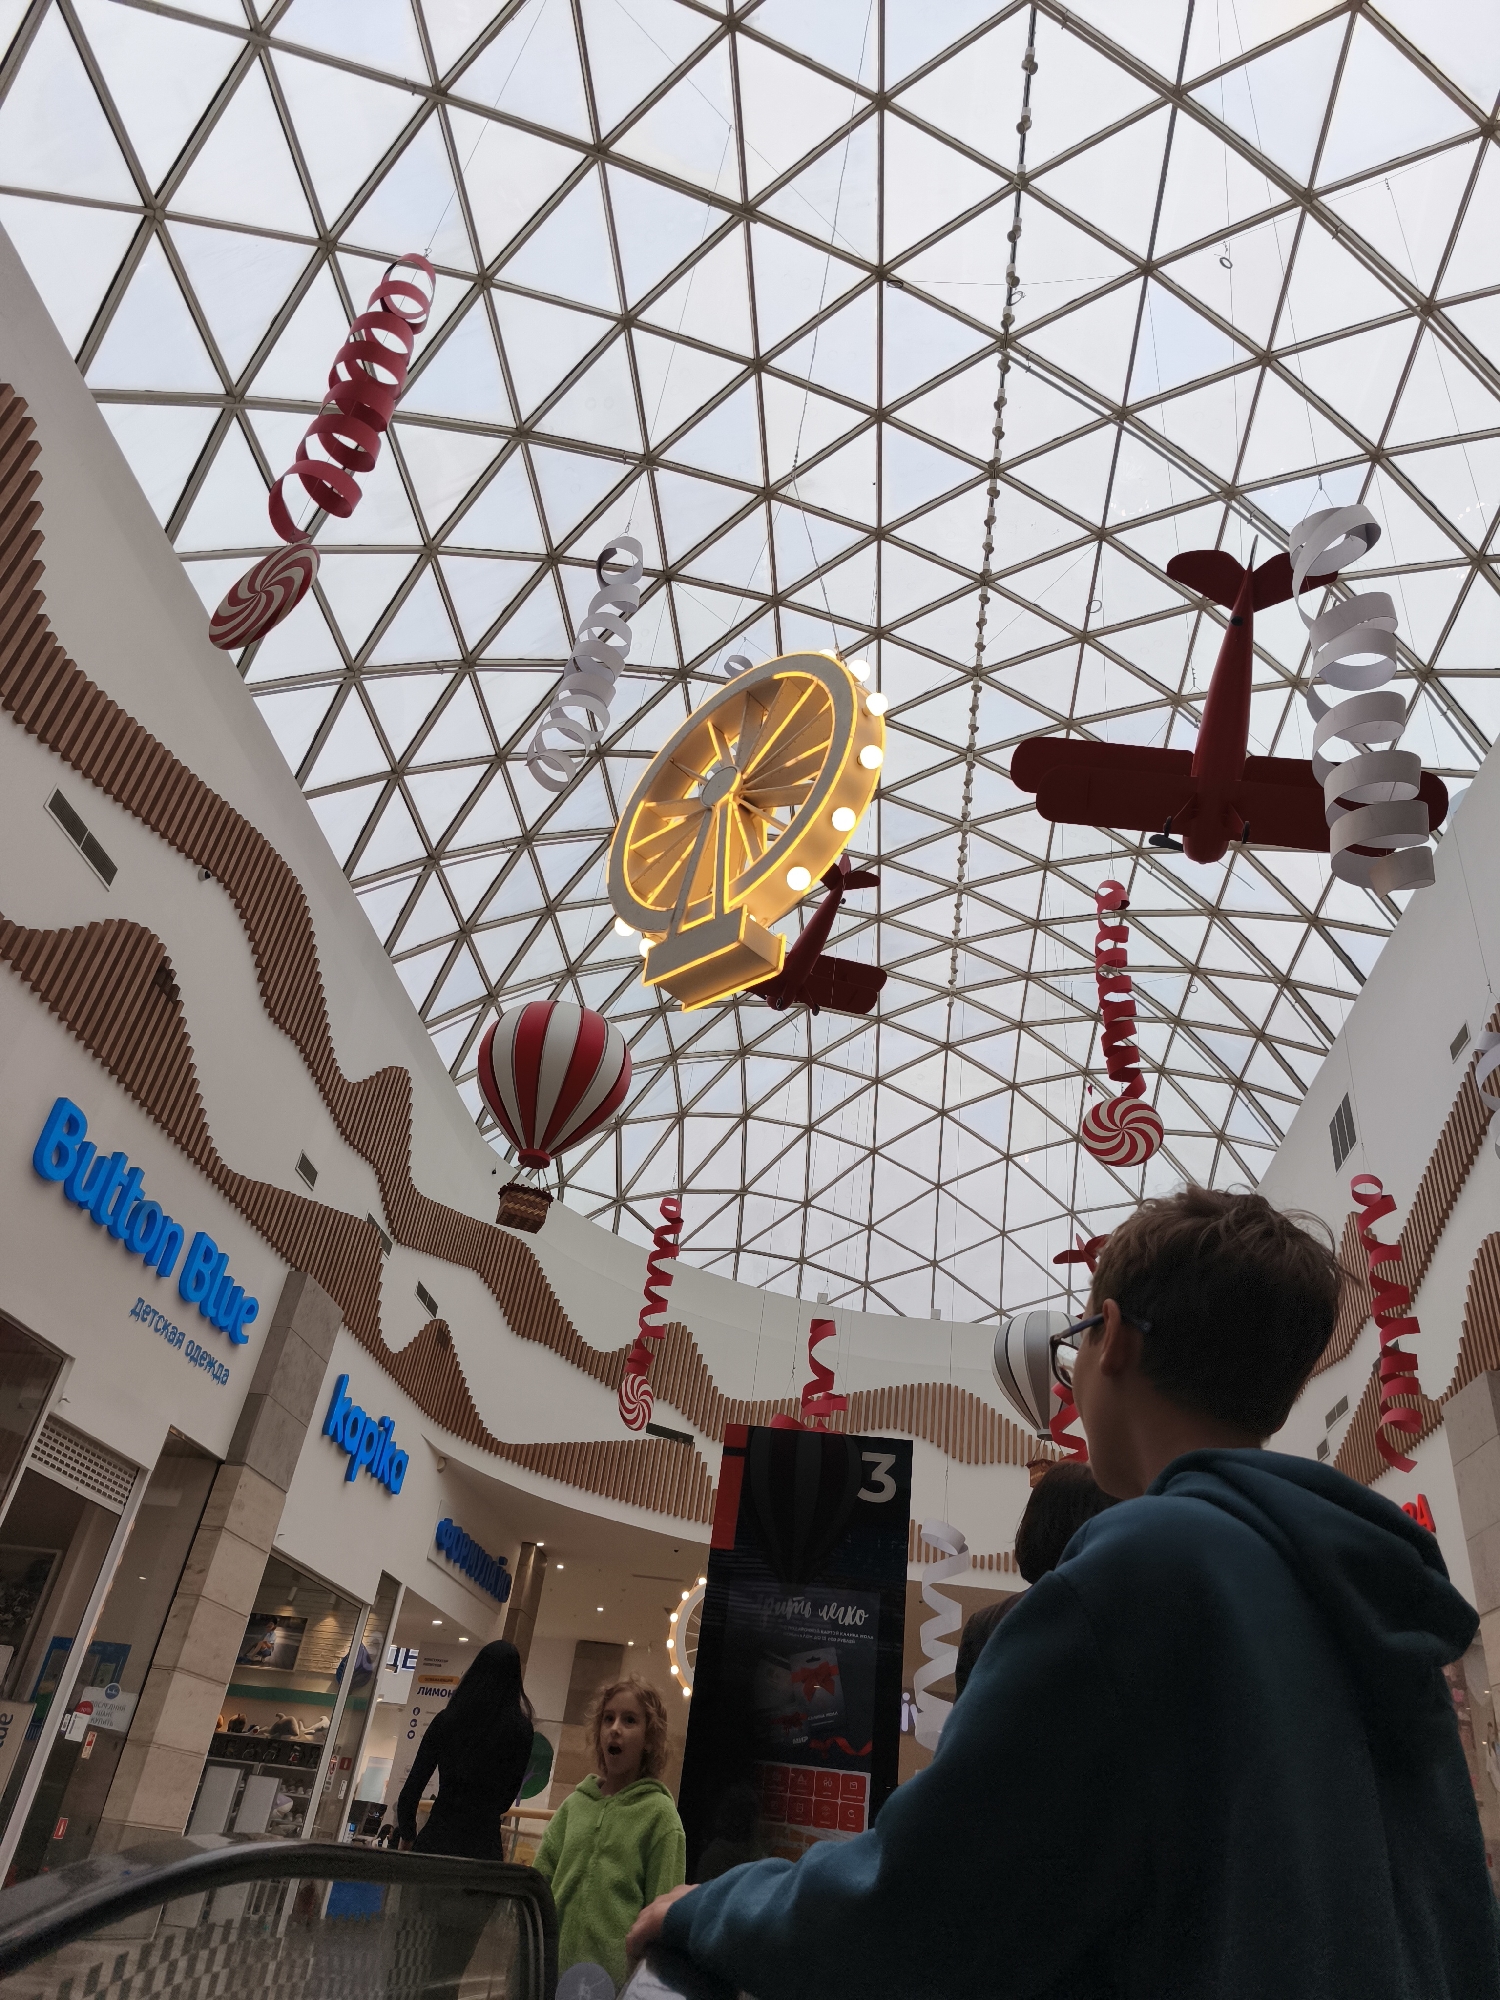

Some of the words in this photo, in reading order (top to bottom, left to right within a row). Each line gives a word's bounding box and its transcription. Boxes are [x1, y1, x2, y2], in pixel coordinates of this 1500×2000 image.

[33, 1097, 185, 1277] Button
[178, 1231, 260, 1345] Blue
[129, 1296, 186, 1351] детская
[184, 1339, 232, 1387] одежда
[323, 1374, 410, 1495] kapika
[857, 1451, 897, 1504] 3
[417, 1686, 455, 1698] ЛИМОН
